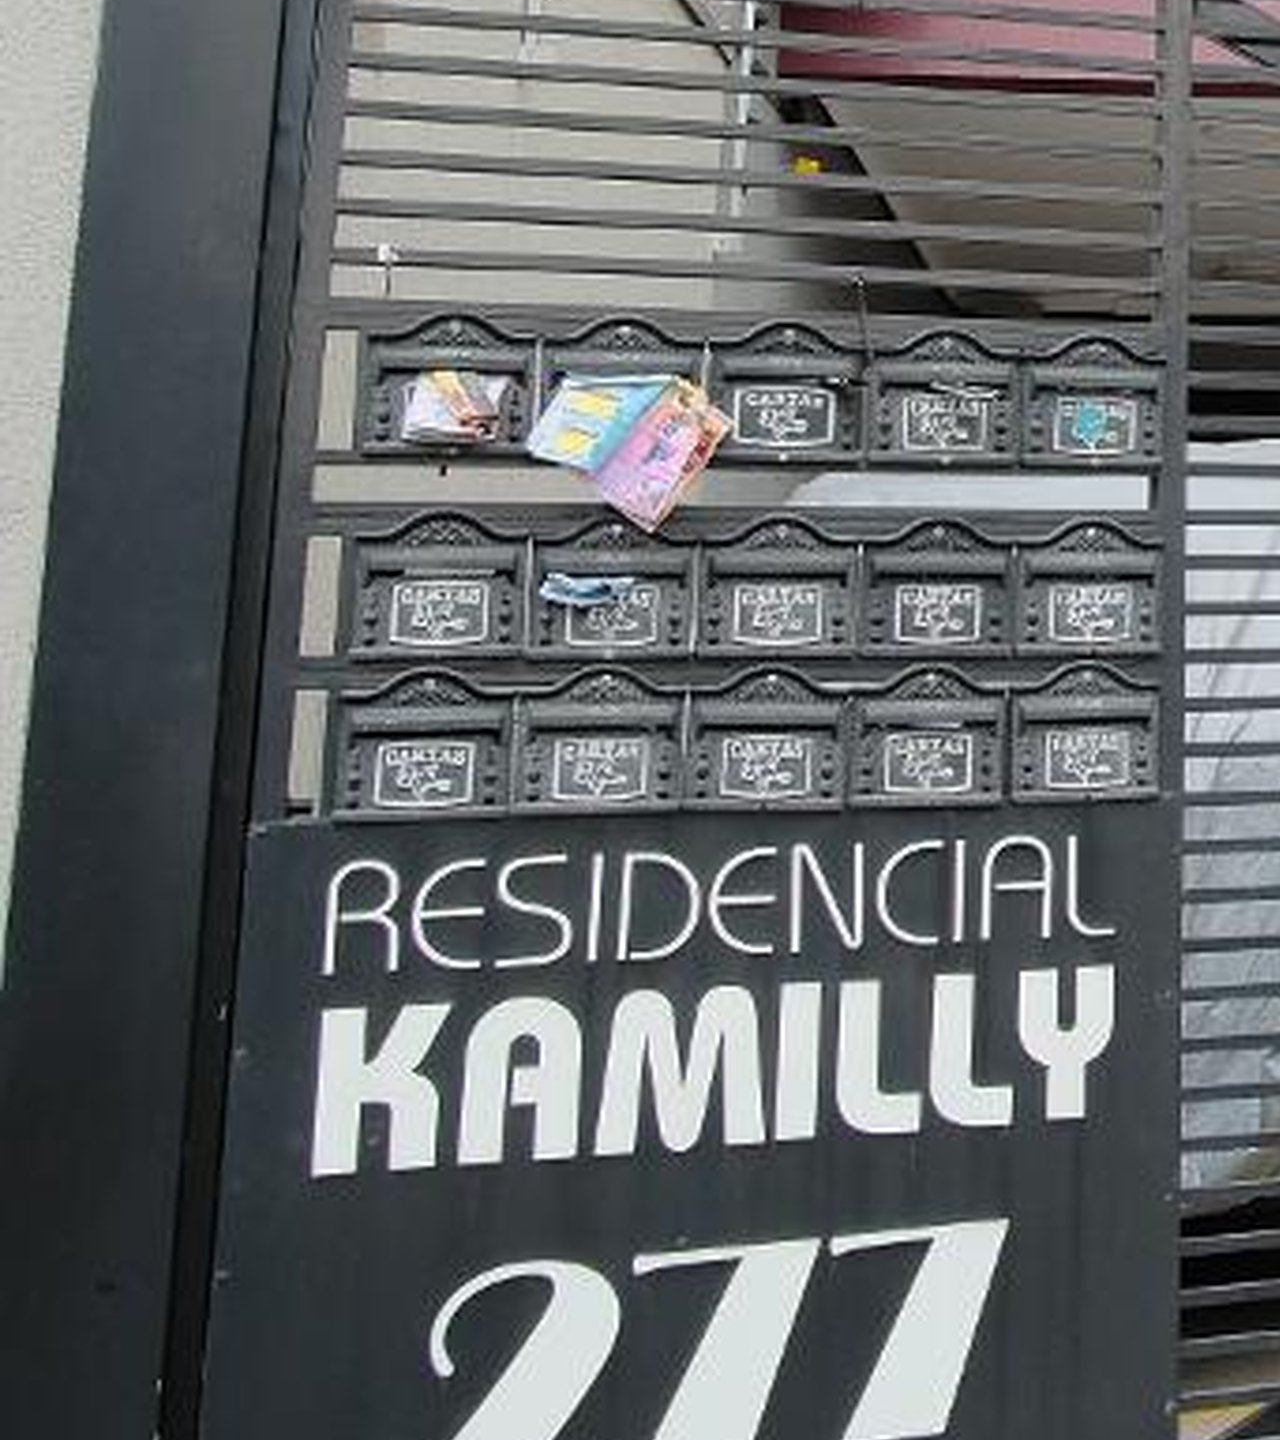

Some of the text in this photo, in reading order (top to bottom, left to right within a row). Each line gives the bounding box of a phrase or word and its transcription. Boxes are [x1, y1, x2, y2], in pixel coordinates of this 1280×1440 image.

[744, 392, 825, 409] CARTAS
[323, 835, 1116, 975] RESIDENCIAL
[311, 964, 1116, 1177] KAMILLY
